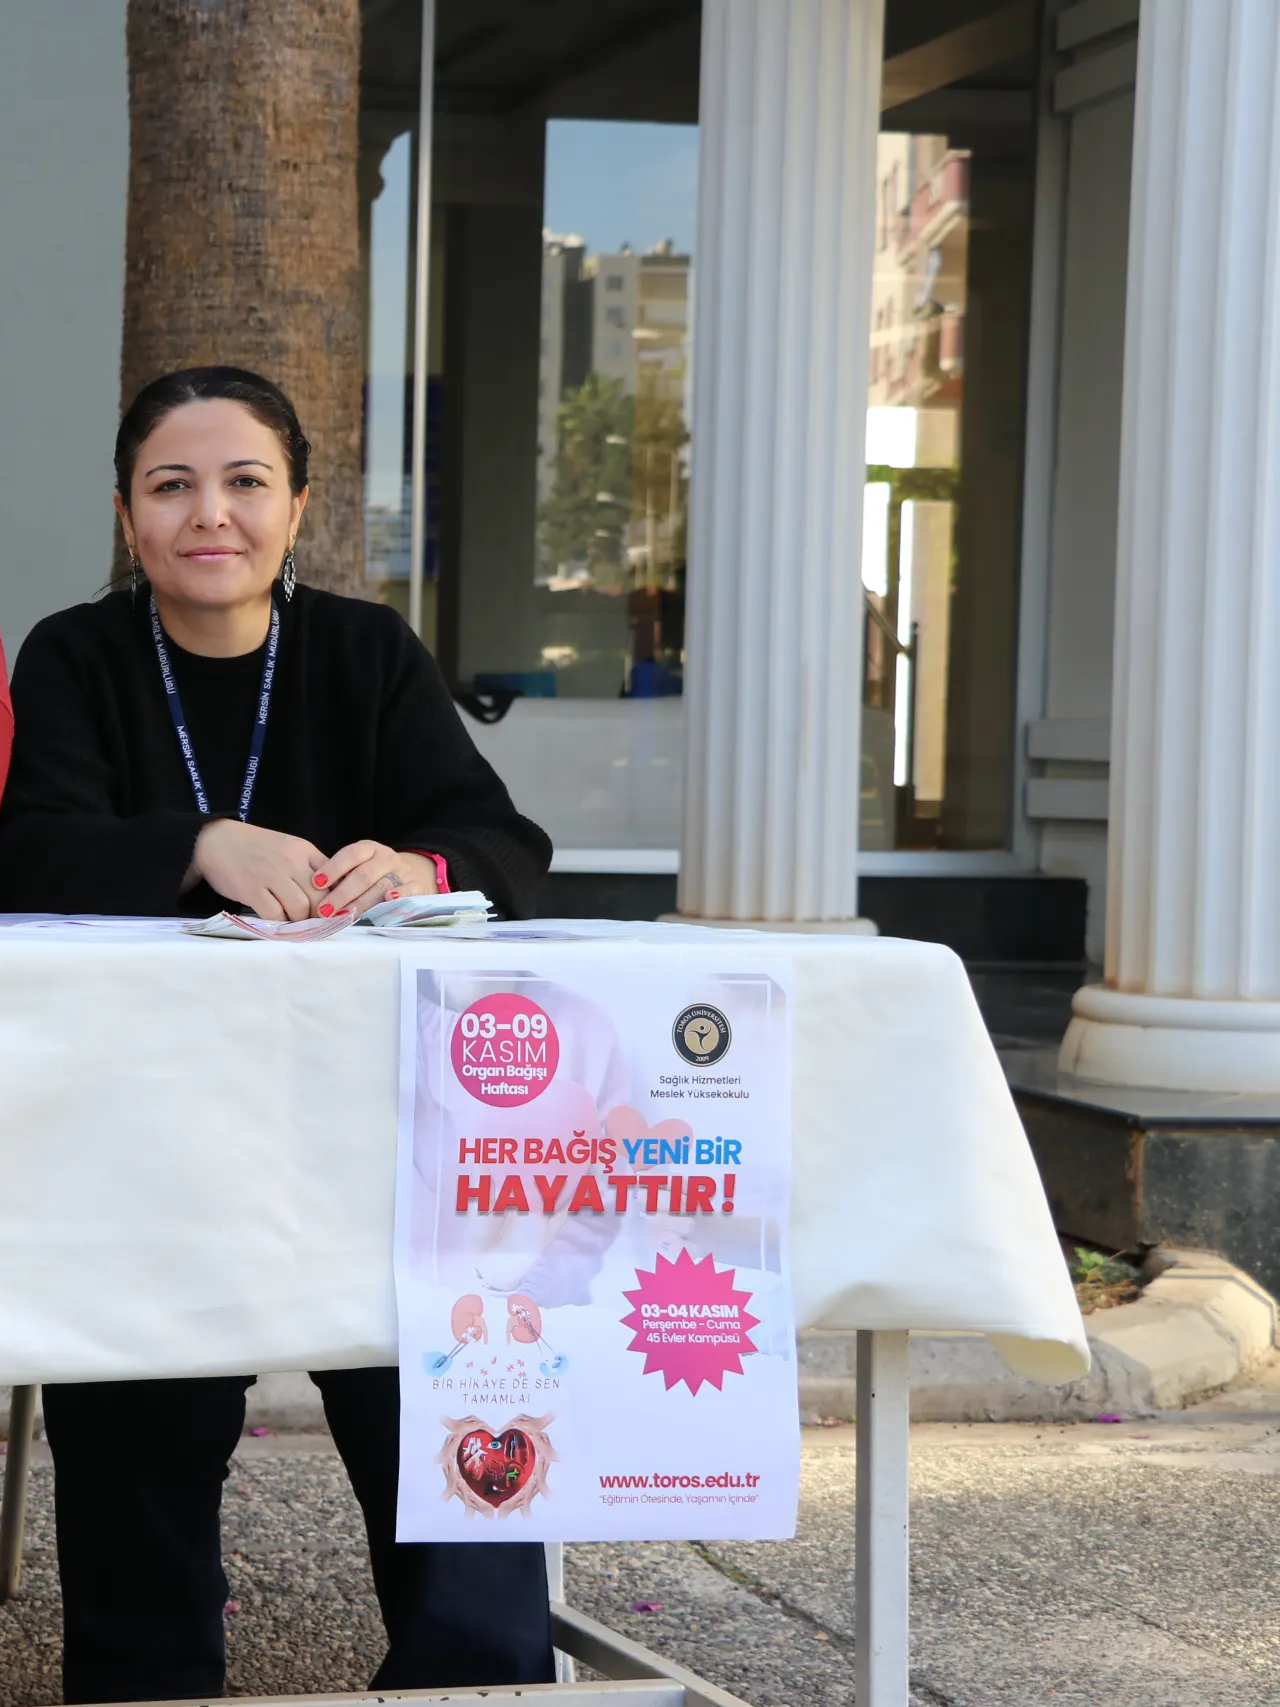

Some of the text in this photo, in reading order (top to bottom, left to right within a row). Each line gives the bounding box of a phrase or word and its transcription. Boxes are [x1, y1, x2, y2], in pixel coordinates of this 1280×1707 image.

[177, 725, 192, 759] MERSİN
[461, 1013, 548, 1039] 03-09
[677, 1015, 692, 1033] TOROS
[463, 1040, 546, 1063] KASIM
[462, 1064, 547, 1080] Organ Bağışı
[481, 1082, 529, 1095] Haftası
[660, 1076, 741, 1086] Sağlık Hizmetleri
[650, 1089, 749, 1099] Meslek Yüksekokulu
[459, 1138, 518, 1164] HER
[524, 1130, 617, 1174] BAĞIŞ
[456, 1174, 736, 1213] HAYATTIR!
[641, 1304, 738, 1318] 03-04 KASIM
[643, 1319, 696, 1332] Perşembe
[706, 1320, 741, 1330] Cuma
[646, 1333, 740, 1346] 45 Evler Kampüsü
[432, 1377, 560, 1389] BİR HİKAYE DE SEN
[599, 1472, 760, 1488] www.toros.edu.tr
[640, 1493, 683, 1504] Ötesinde,
[686, 1494, 727, 1505] Yaşamın
